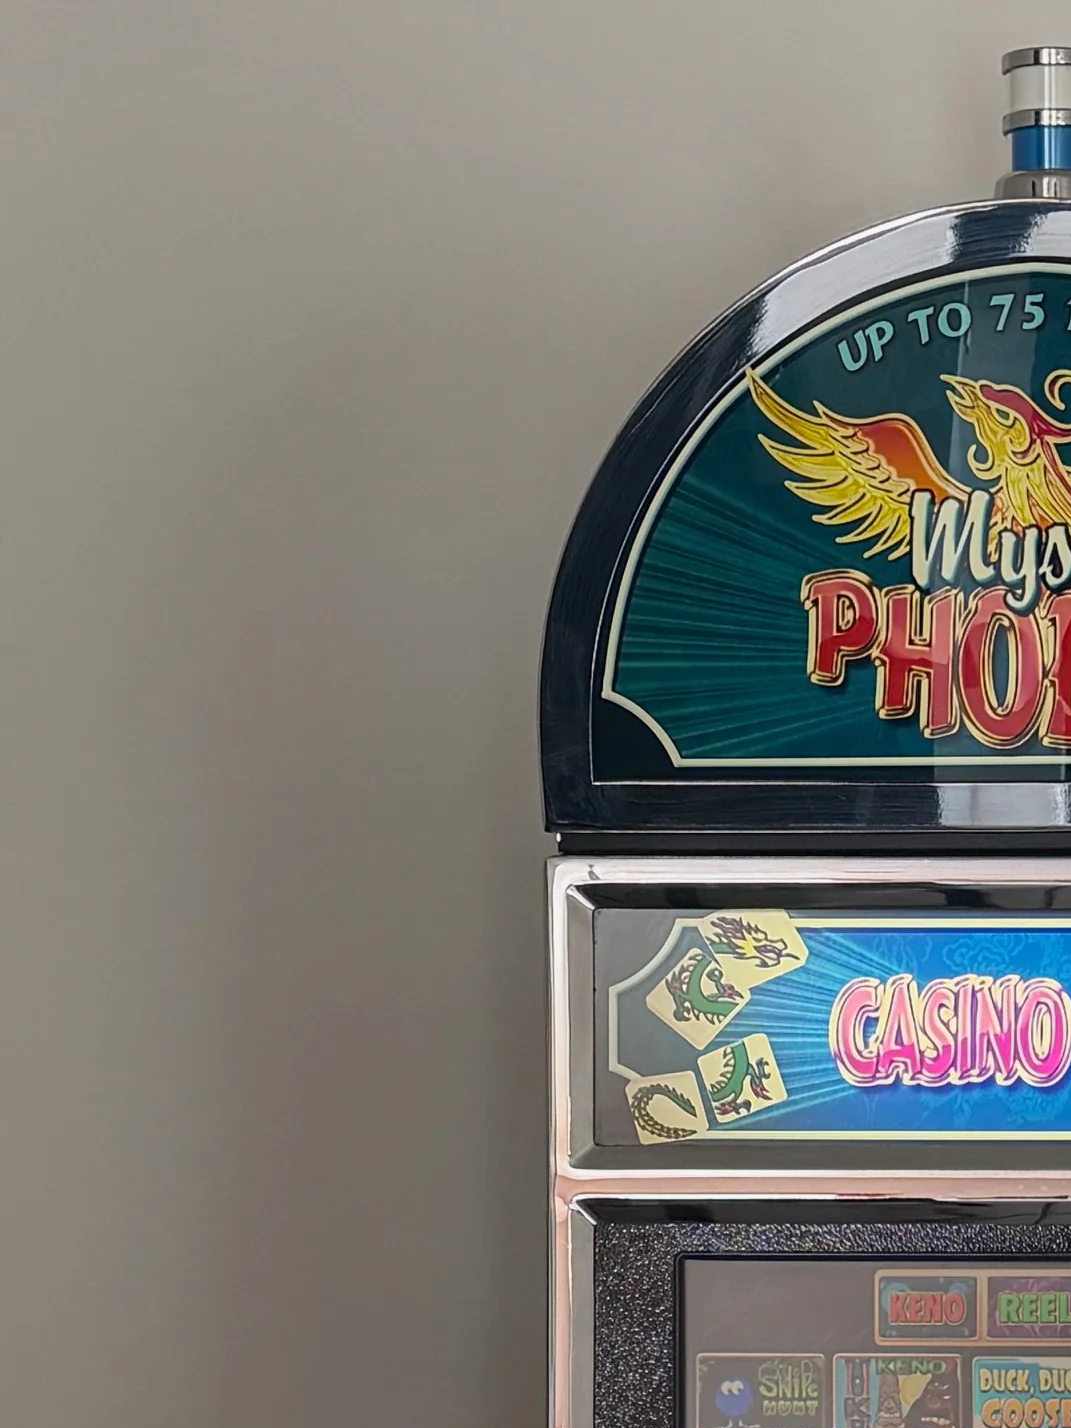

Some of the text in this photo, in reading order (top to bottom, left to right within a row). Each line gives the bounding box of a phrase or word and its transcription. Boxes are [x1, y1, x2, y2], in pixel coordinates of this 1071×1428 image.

[838, 320, 894, 371] UP
[908, 304, 971, 344] TO
[990, 294, 1045, 331] 75
[889, 1291, 967, 1325] KENO
[876, 1359, 946, 1374] KENO
[979, 1368, 1034, 1394] DUCK,
